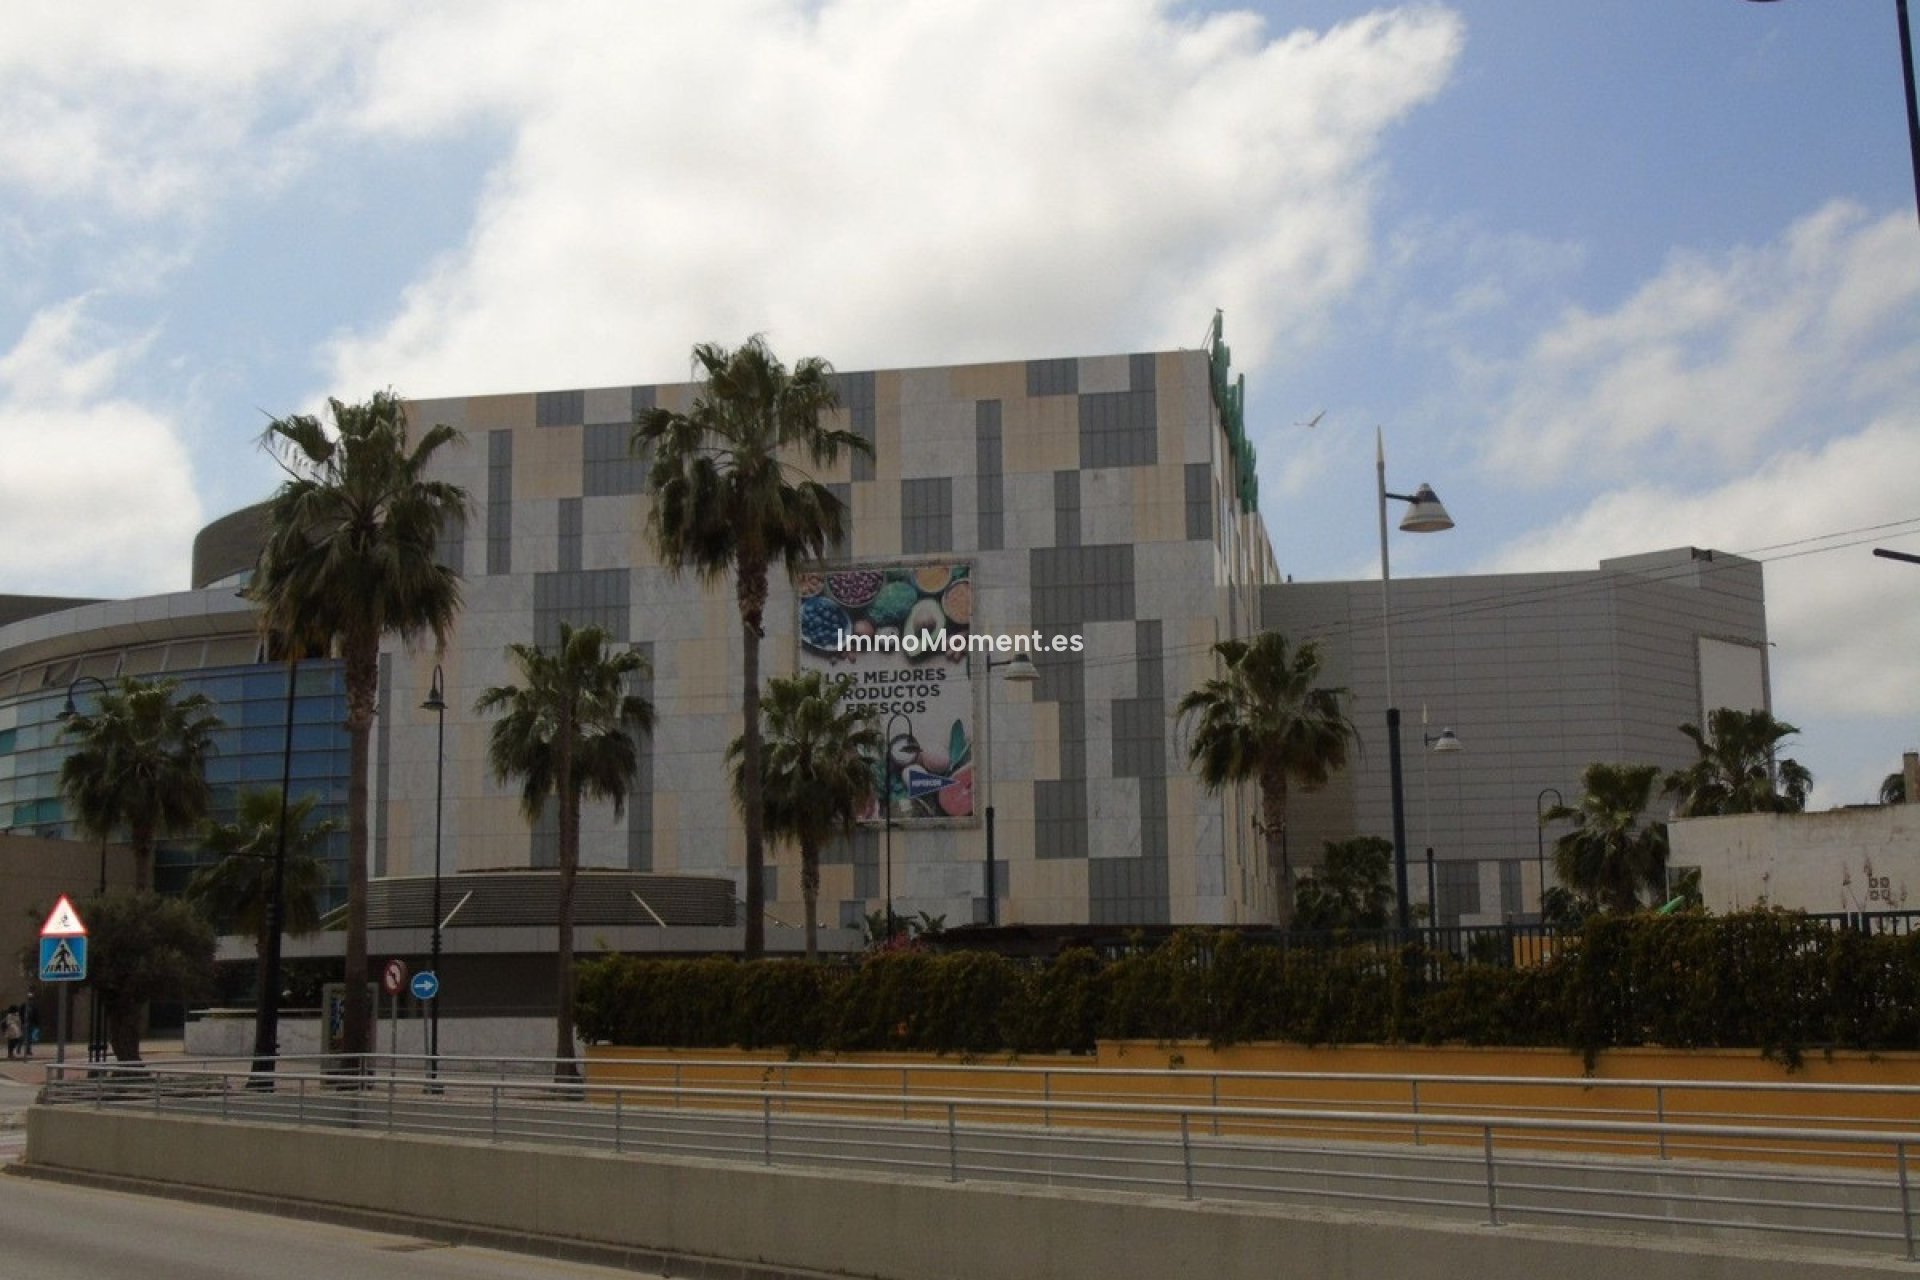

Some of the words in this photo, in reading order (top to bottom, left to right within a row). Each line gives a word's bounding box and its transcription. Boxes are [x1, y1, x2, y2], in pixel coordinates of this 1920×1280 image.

[825, 671, 859, 686] LOS
[863, 668, 947, 683] MEJORES
[840, 684, 940, 700] RODUCTOS
